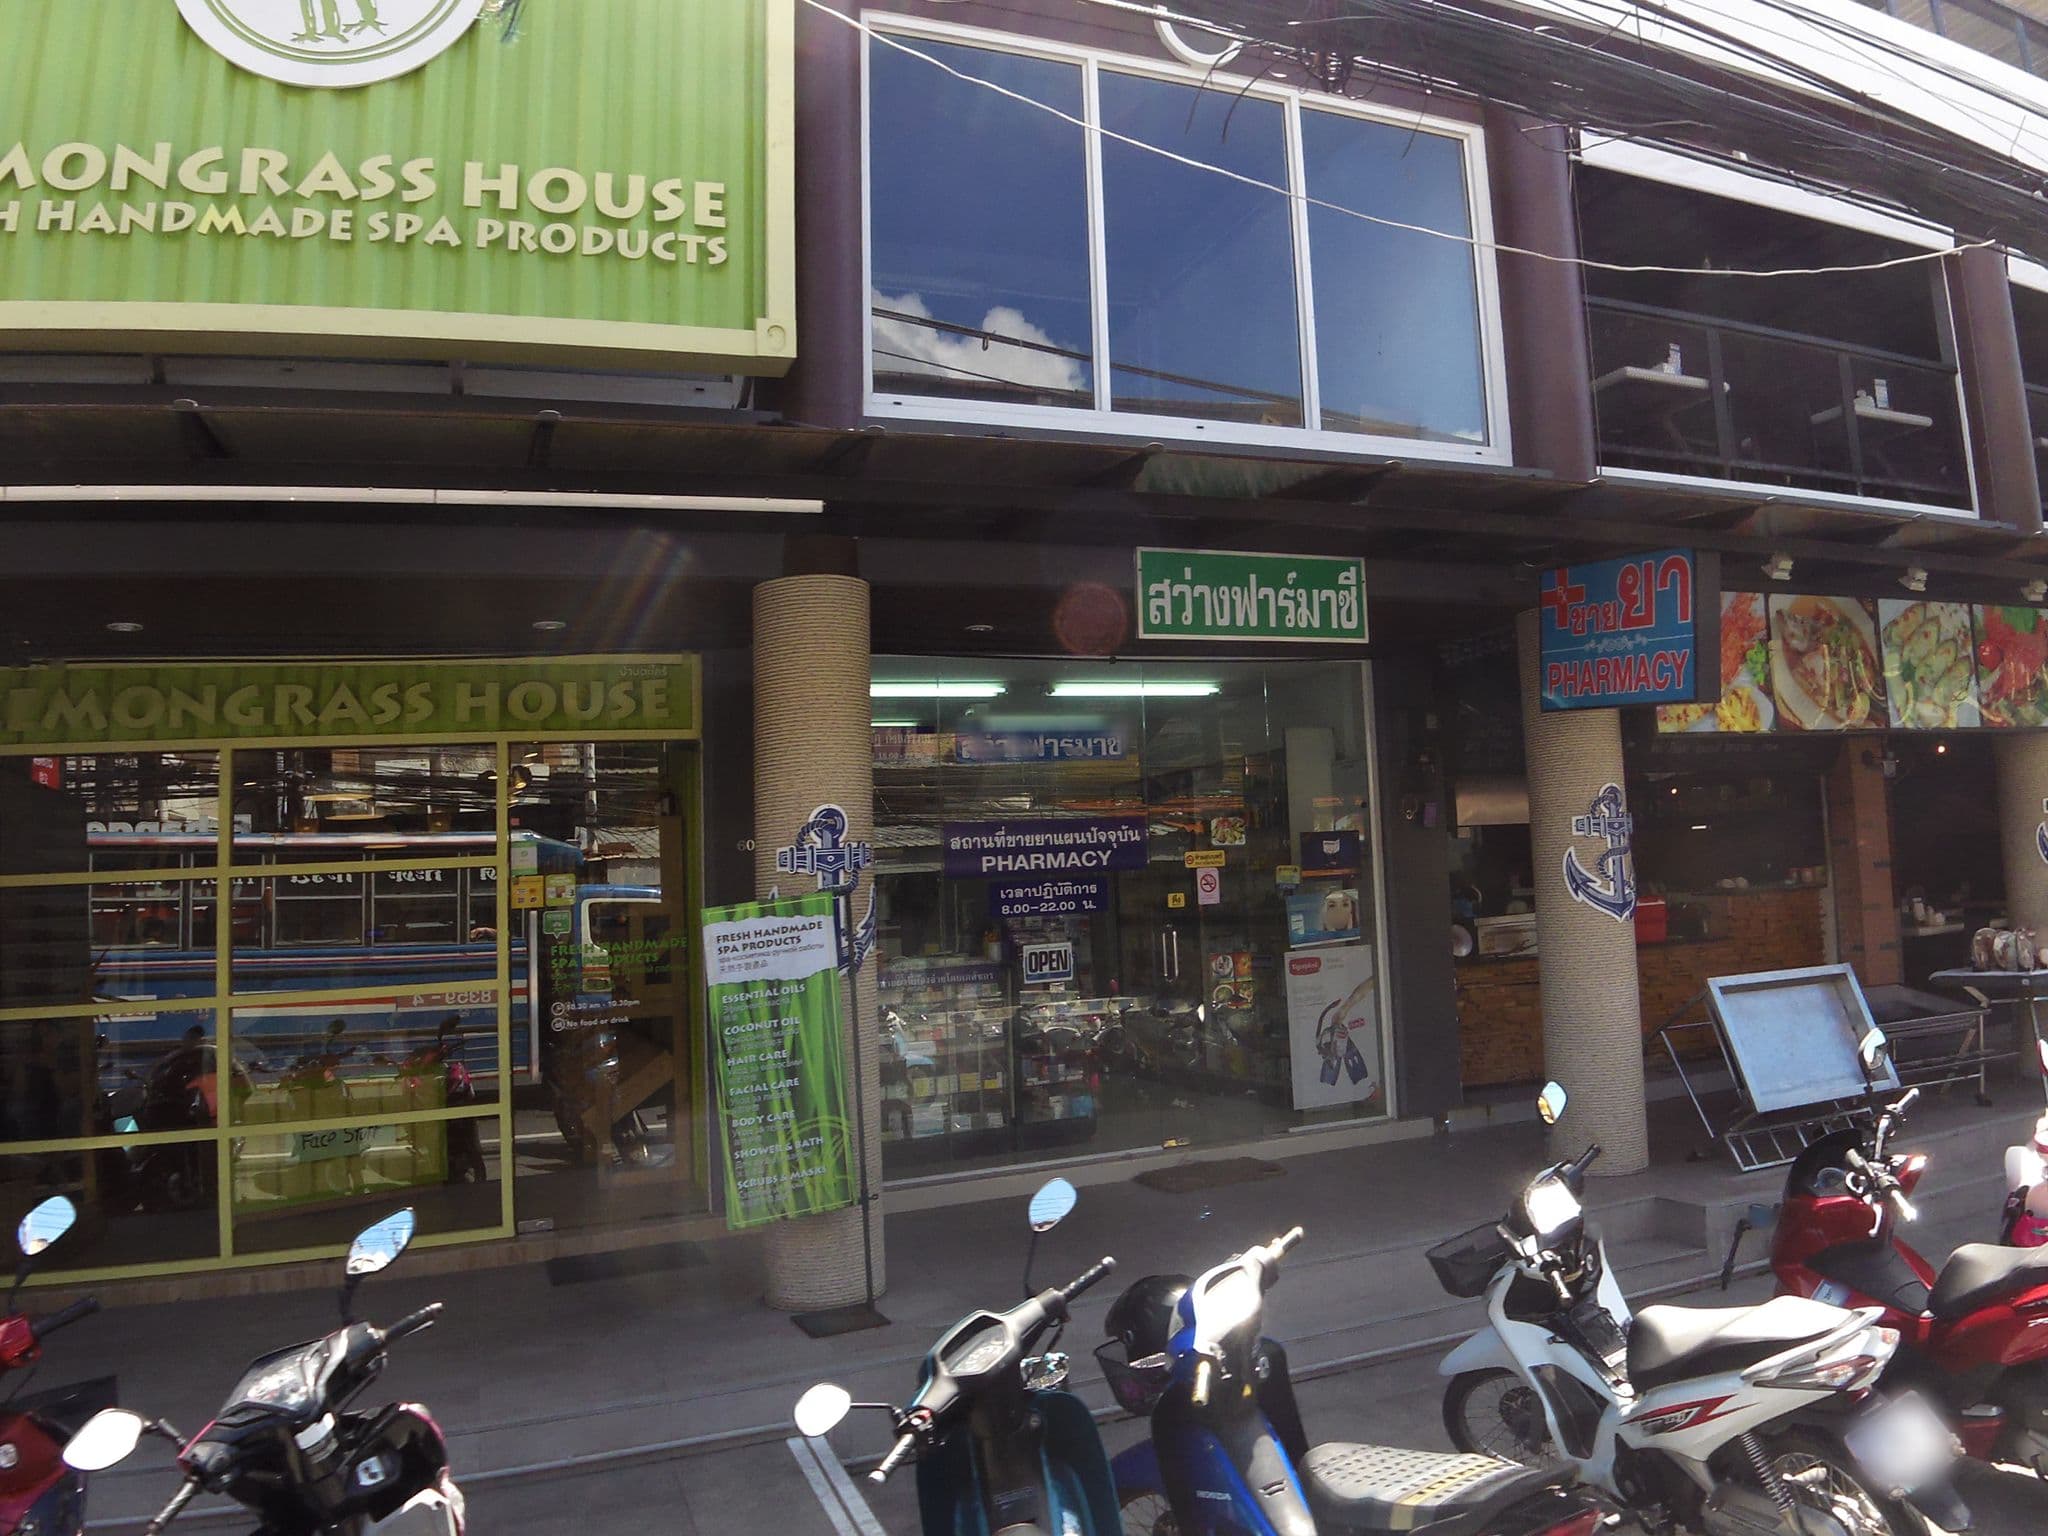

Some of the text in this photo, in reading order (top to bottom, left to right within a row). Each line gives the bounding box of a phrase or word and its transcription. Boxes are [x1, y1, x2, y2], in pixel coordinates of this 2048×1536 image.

[463, 160, 728, 229] HOUSE
[36, 200, 352, 241] HANDMADE
[368, 211, 462, 248] SPA
[476, 218, 728, 266] PRODUCTS
[1149, 566, 1359, 630] สว่างฟาร์มาซี
[1548, 649, 1689, 699] PHARMACY
[455, 679, 670, 723] HOUSE
[950, 825, 1140, 850] สถานที่ขายยาแผนปัจจุบัน
[982, 850, 1113, 873] PHARMACY
[716, 921, 823, 944] FRESH HANDMADE
[718, 935, 802, 956] SPA PRODUCTS
[1028, 949, 1069, 974] OPEN
[722, 983, 806, 1004] ESSENTIAL OILS
[610, 1015, 629, 1025] drink
[724, 1017, 801, 1036] COCONUT OIL
[759, 1050, 789, 1062] CARE
[730, 1078, 800, 1097] FACIAL CARE
[732, 1110, 795, 1128] BODY CARE
[734, 1144, 784, 1160] SHOWER
[794, 1136, 824, 1149] BATH
[737, 1175, 778, 1190] SCRUBS
